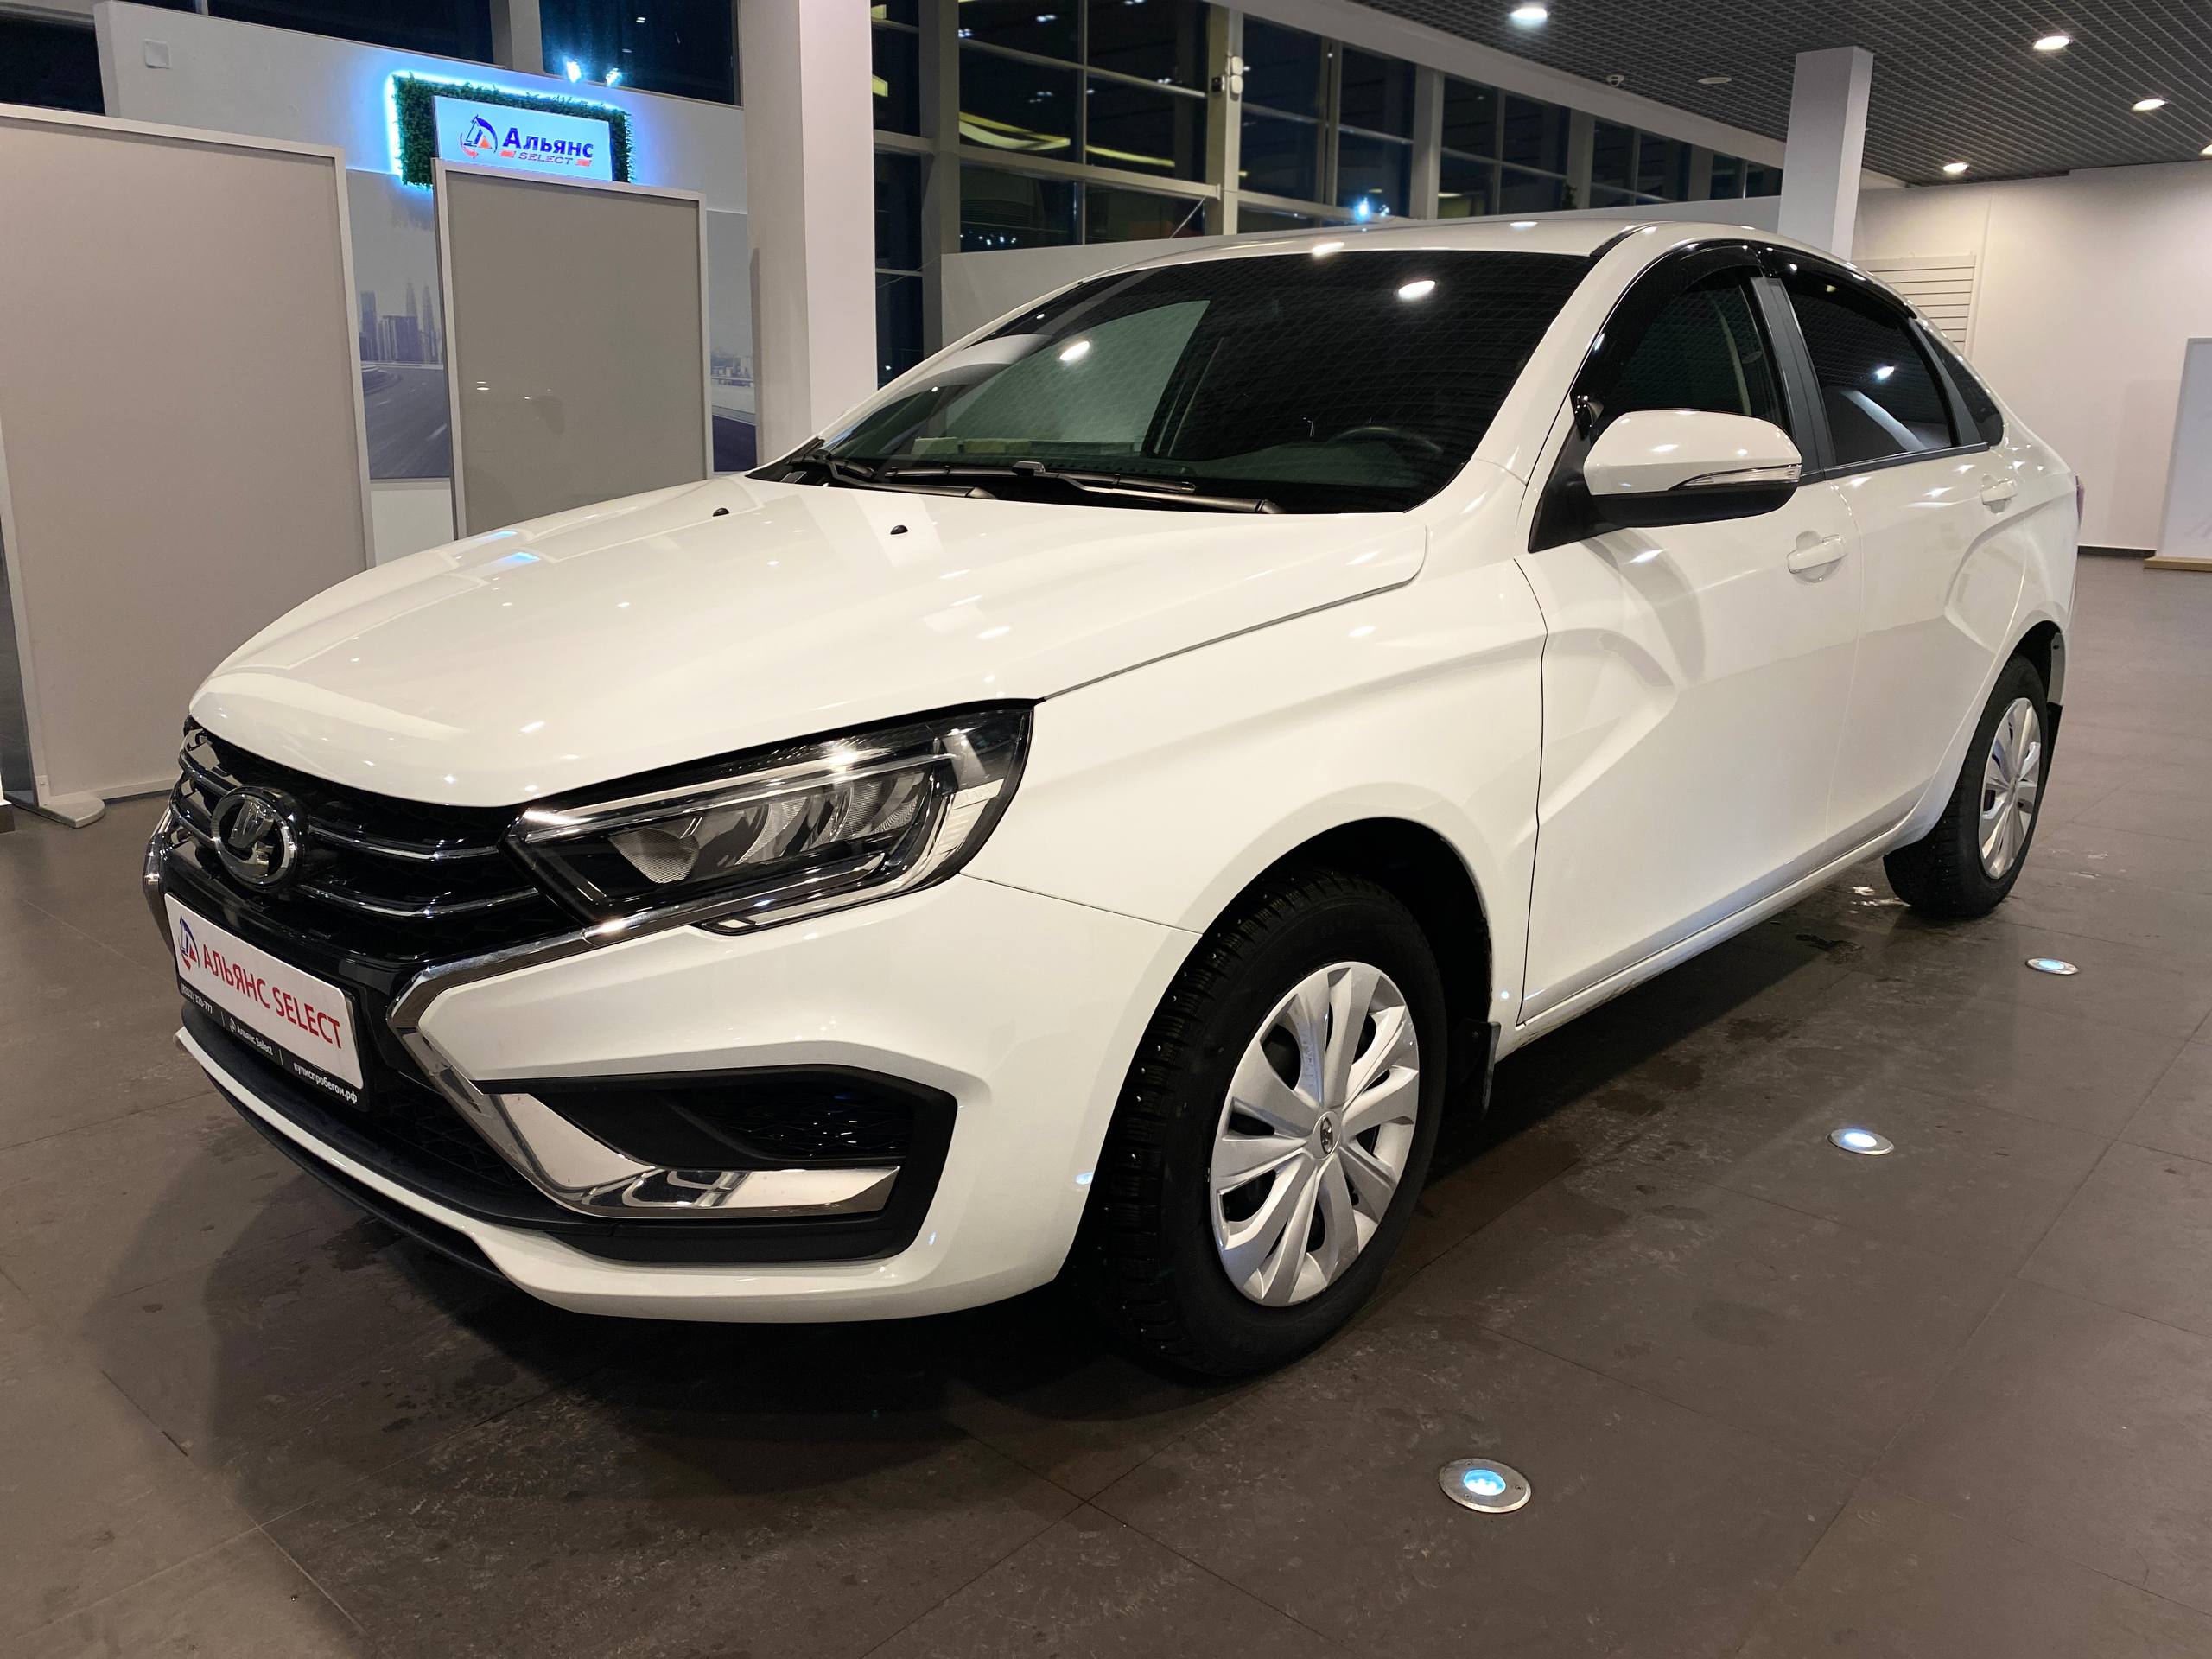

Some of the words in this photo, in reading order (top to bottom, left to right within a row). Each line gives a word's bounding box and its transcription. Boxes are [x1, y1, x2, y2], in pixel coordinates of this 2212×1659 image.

[502, 127, 594, 158] Альянс
[518, 152, 573, 164] SELECT
[202, 944, 270, 1009] АЛЬЯНС
[272, 987, 342, 1049] SELECT
